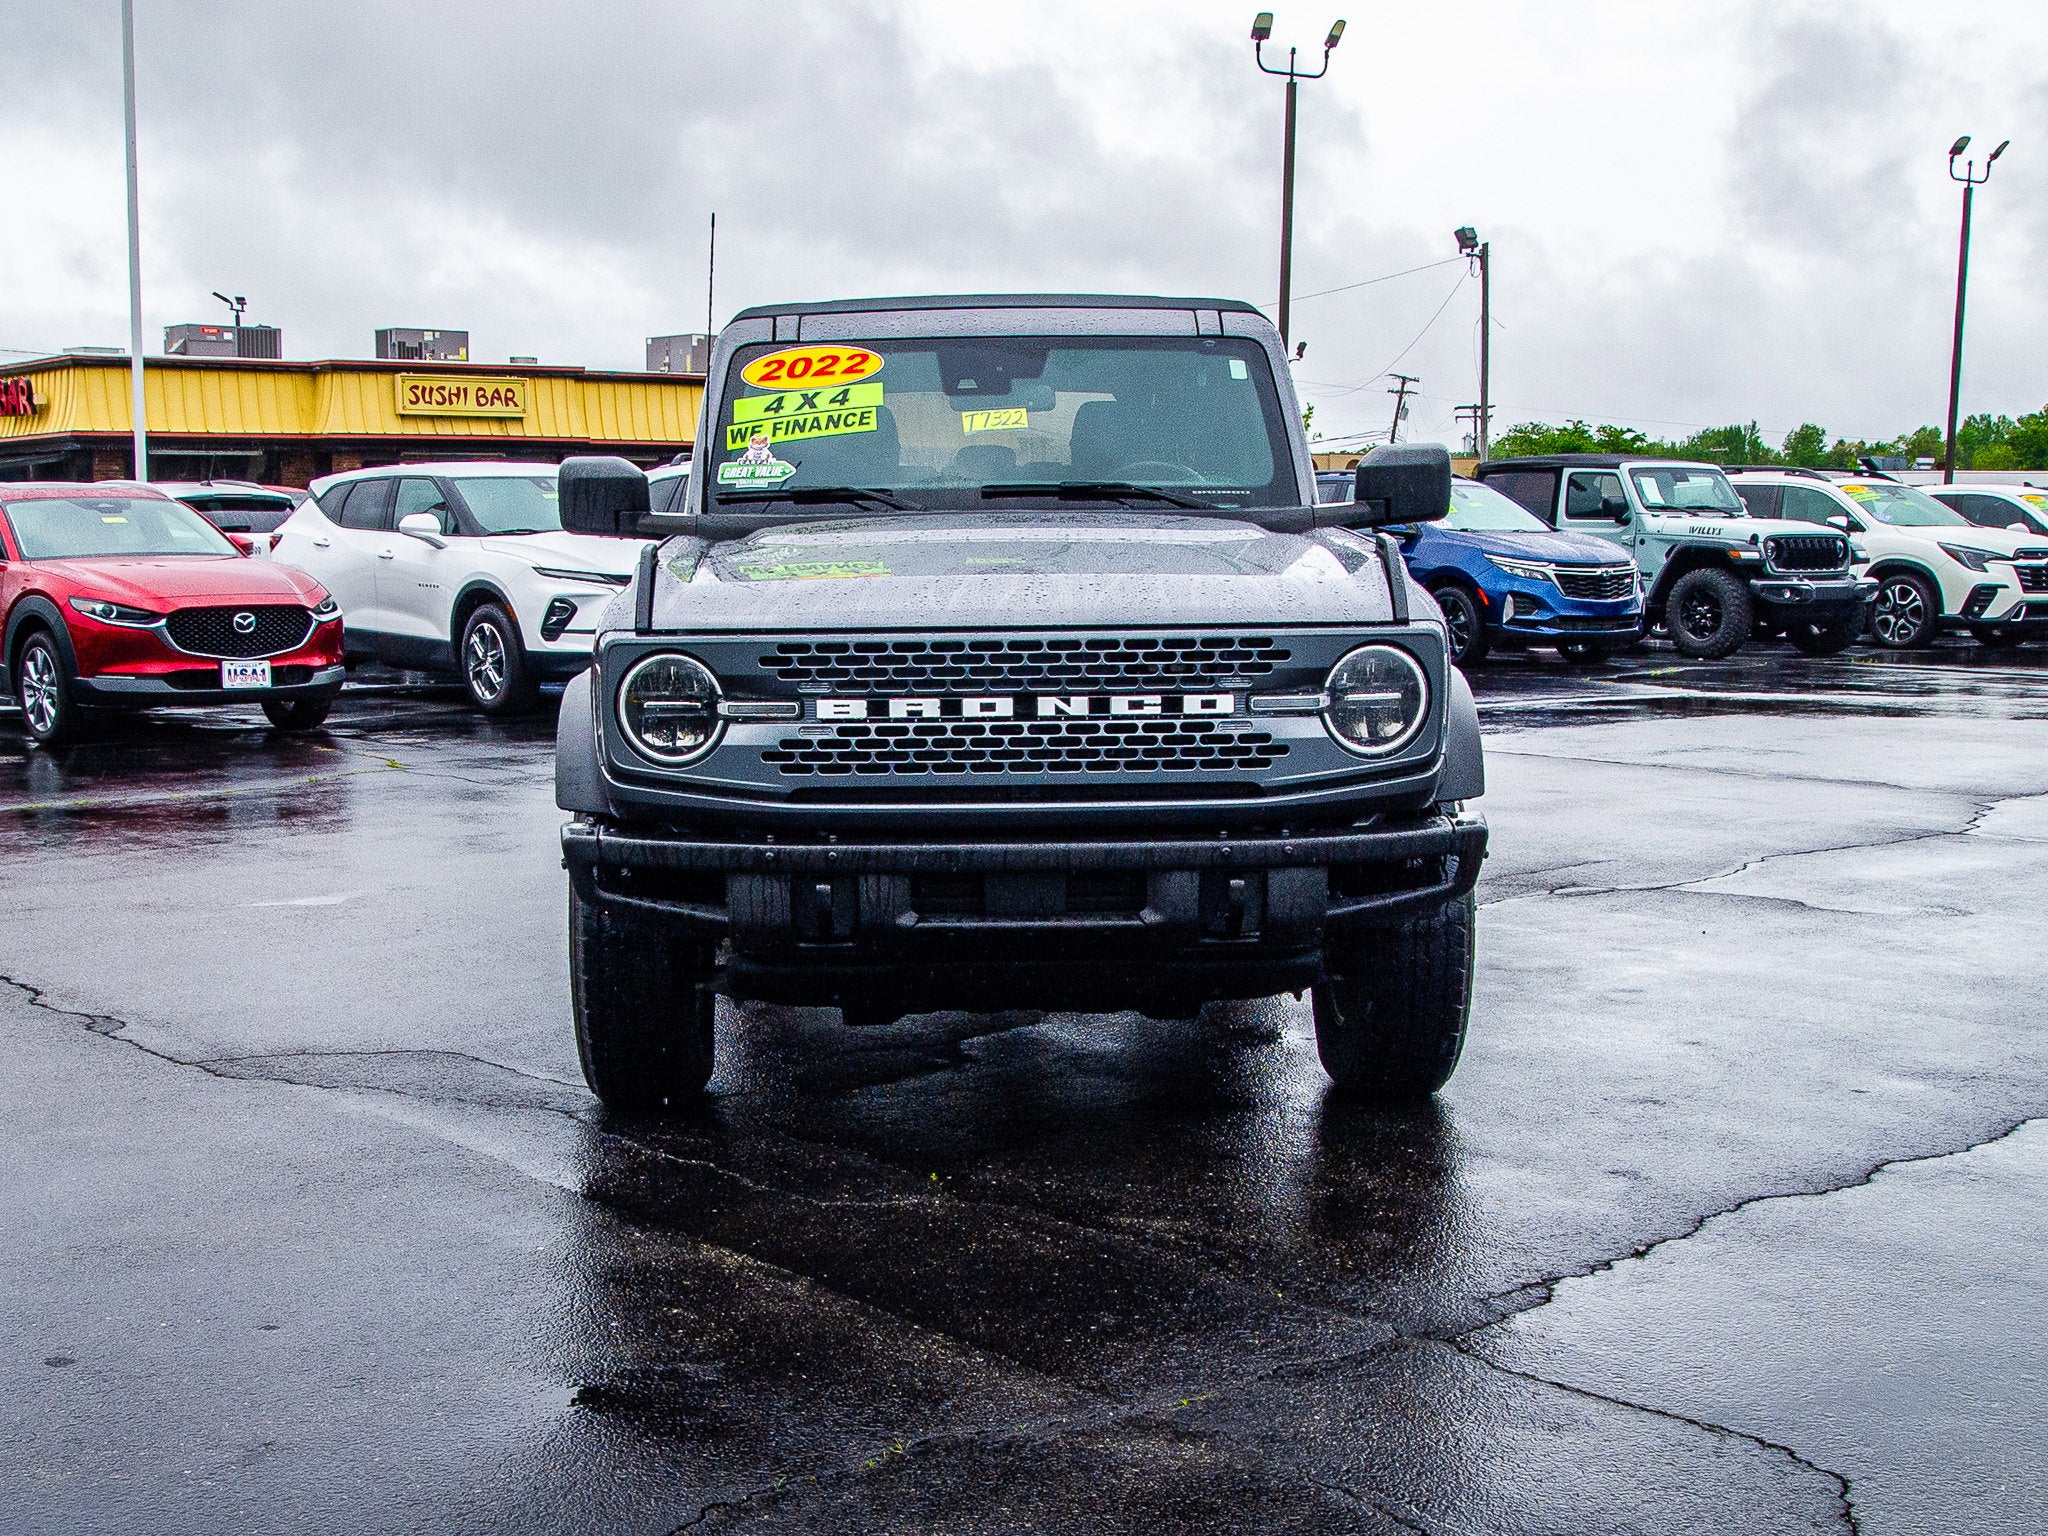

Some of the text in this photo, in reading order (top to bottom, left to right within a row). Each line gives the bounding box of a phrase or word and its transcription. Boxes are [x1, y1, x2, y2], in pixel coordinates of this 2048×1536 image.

[756, 353, 870, 383] 2022
[408, 384, 520, 408] SUSHI BAR
[772, 410, 873, 438] FINANCE
[964, 410, 1026, 431] T7322
[722, 465, 785, 479] GREAT VALUE
[227, 667, 267, 683] USA1
[816, 694, 1234, 719] BRONCO
